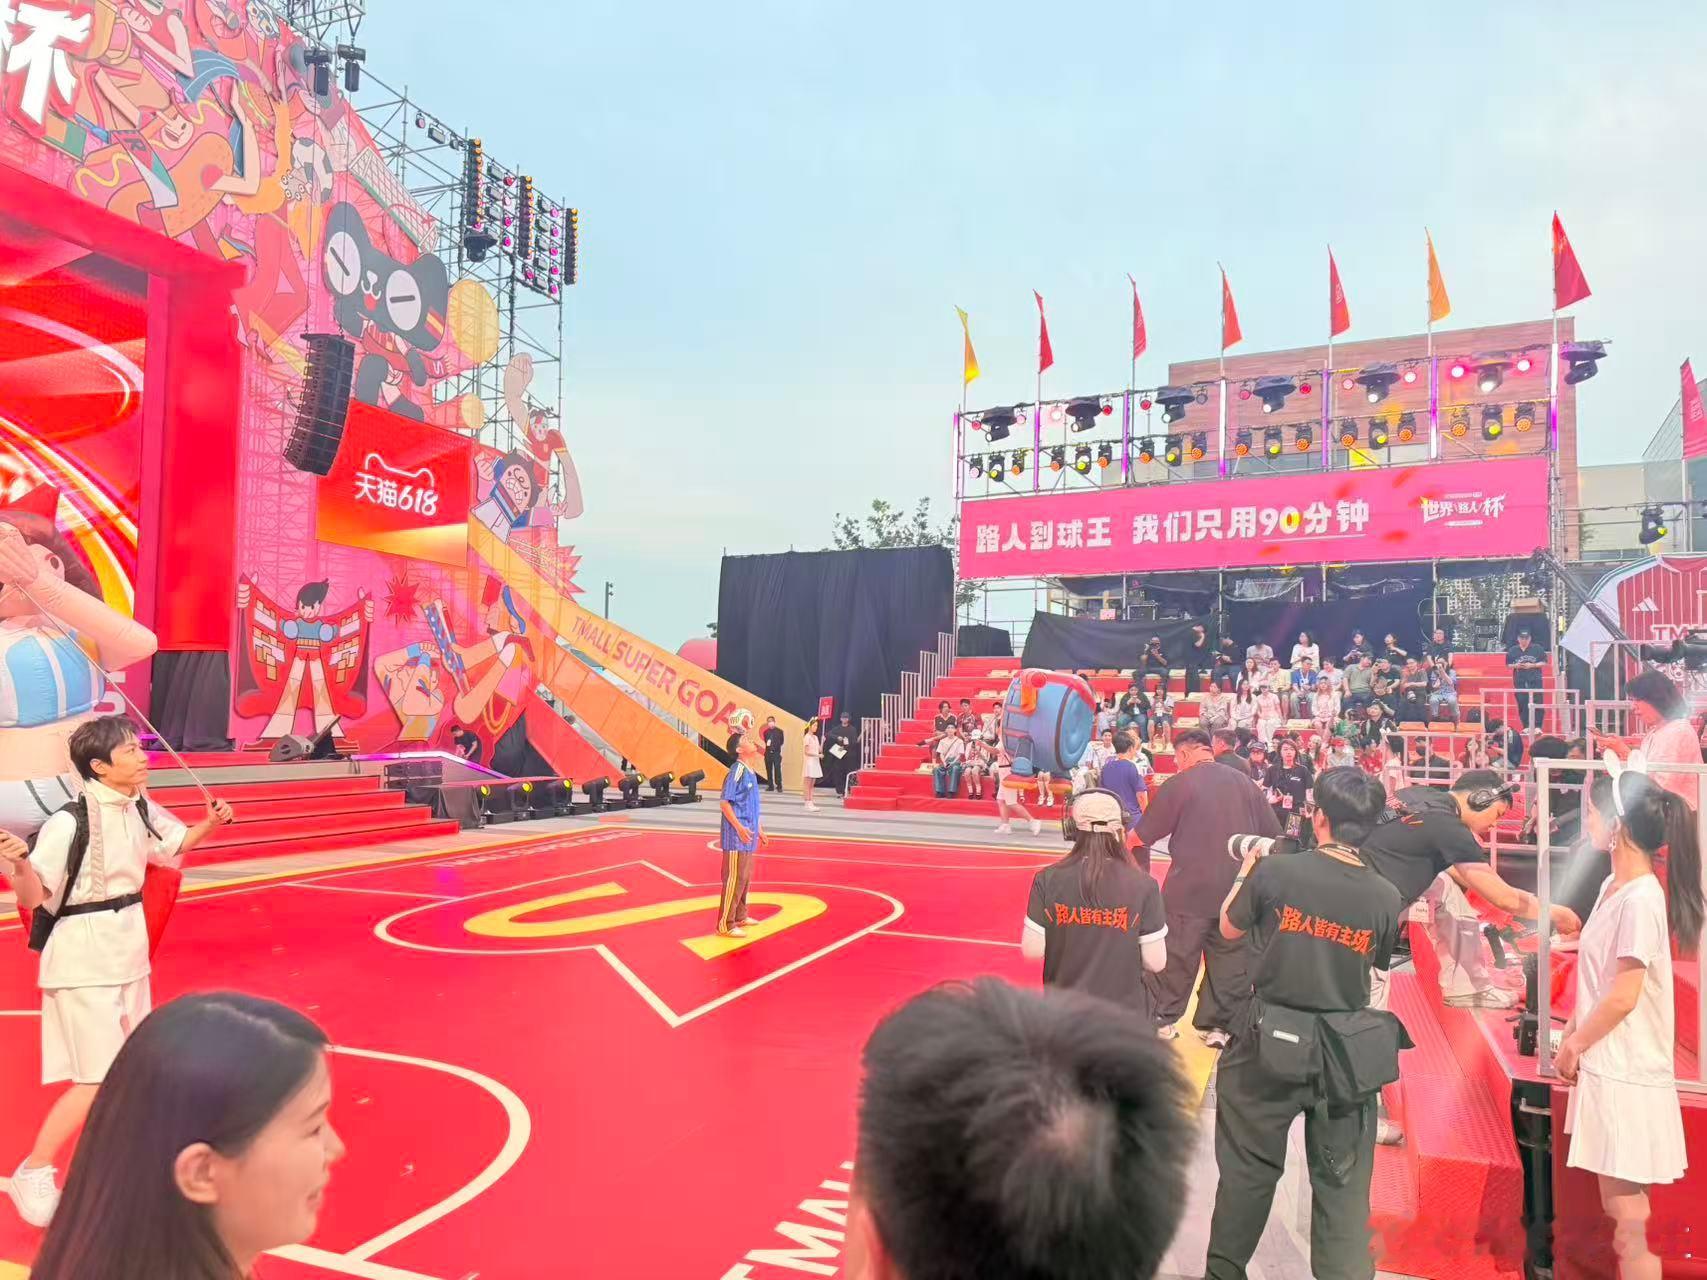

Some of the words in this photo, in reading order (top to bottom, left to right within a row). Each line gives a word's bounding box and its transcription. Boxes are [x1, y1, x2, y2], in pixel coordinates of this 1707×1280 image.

[355, 471, 439, 516] 天猫618
[975, 516, 1112, 554] 路人到球王
[1132, 498, 1370, 546] 我们只用90分钟
[571, 615, 612, 654] TMALL
[611, 640, 678, 696] SUPER
[677, 678, 742, 736] GOA
[1054, 902, 1128, 934] 路人皆有主场
[1279, 903, 1374, 954] 路人皆有主场
